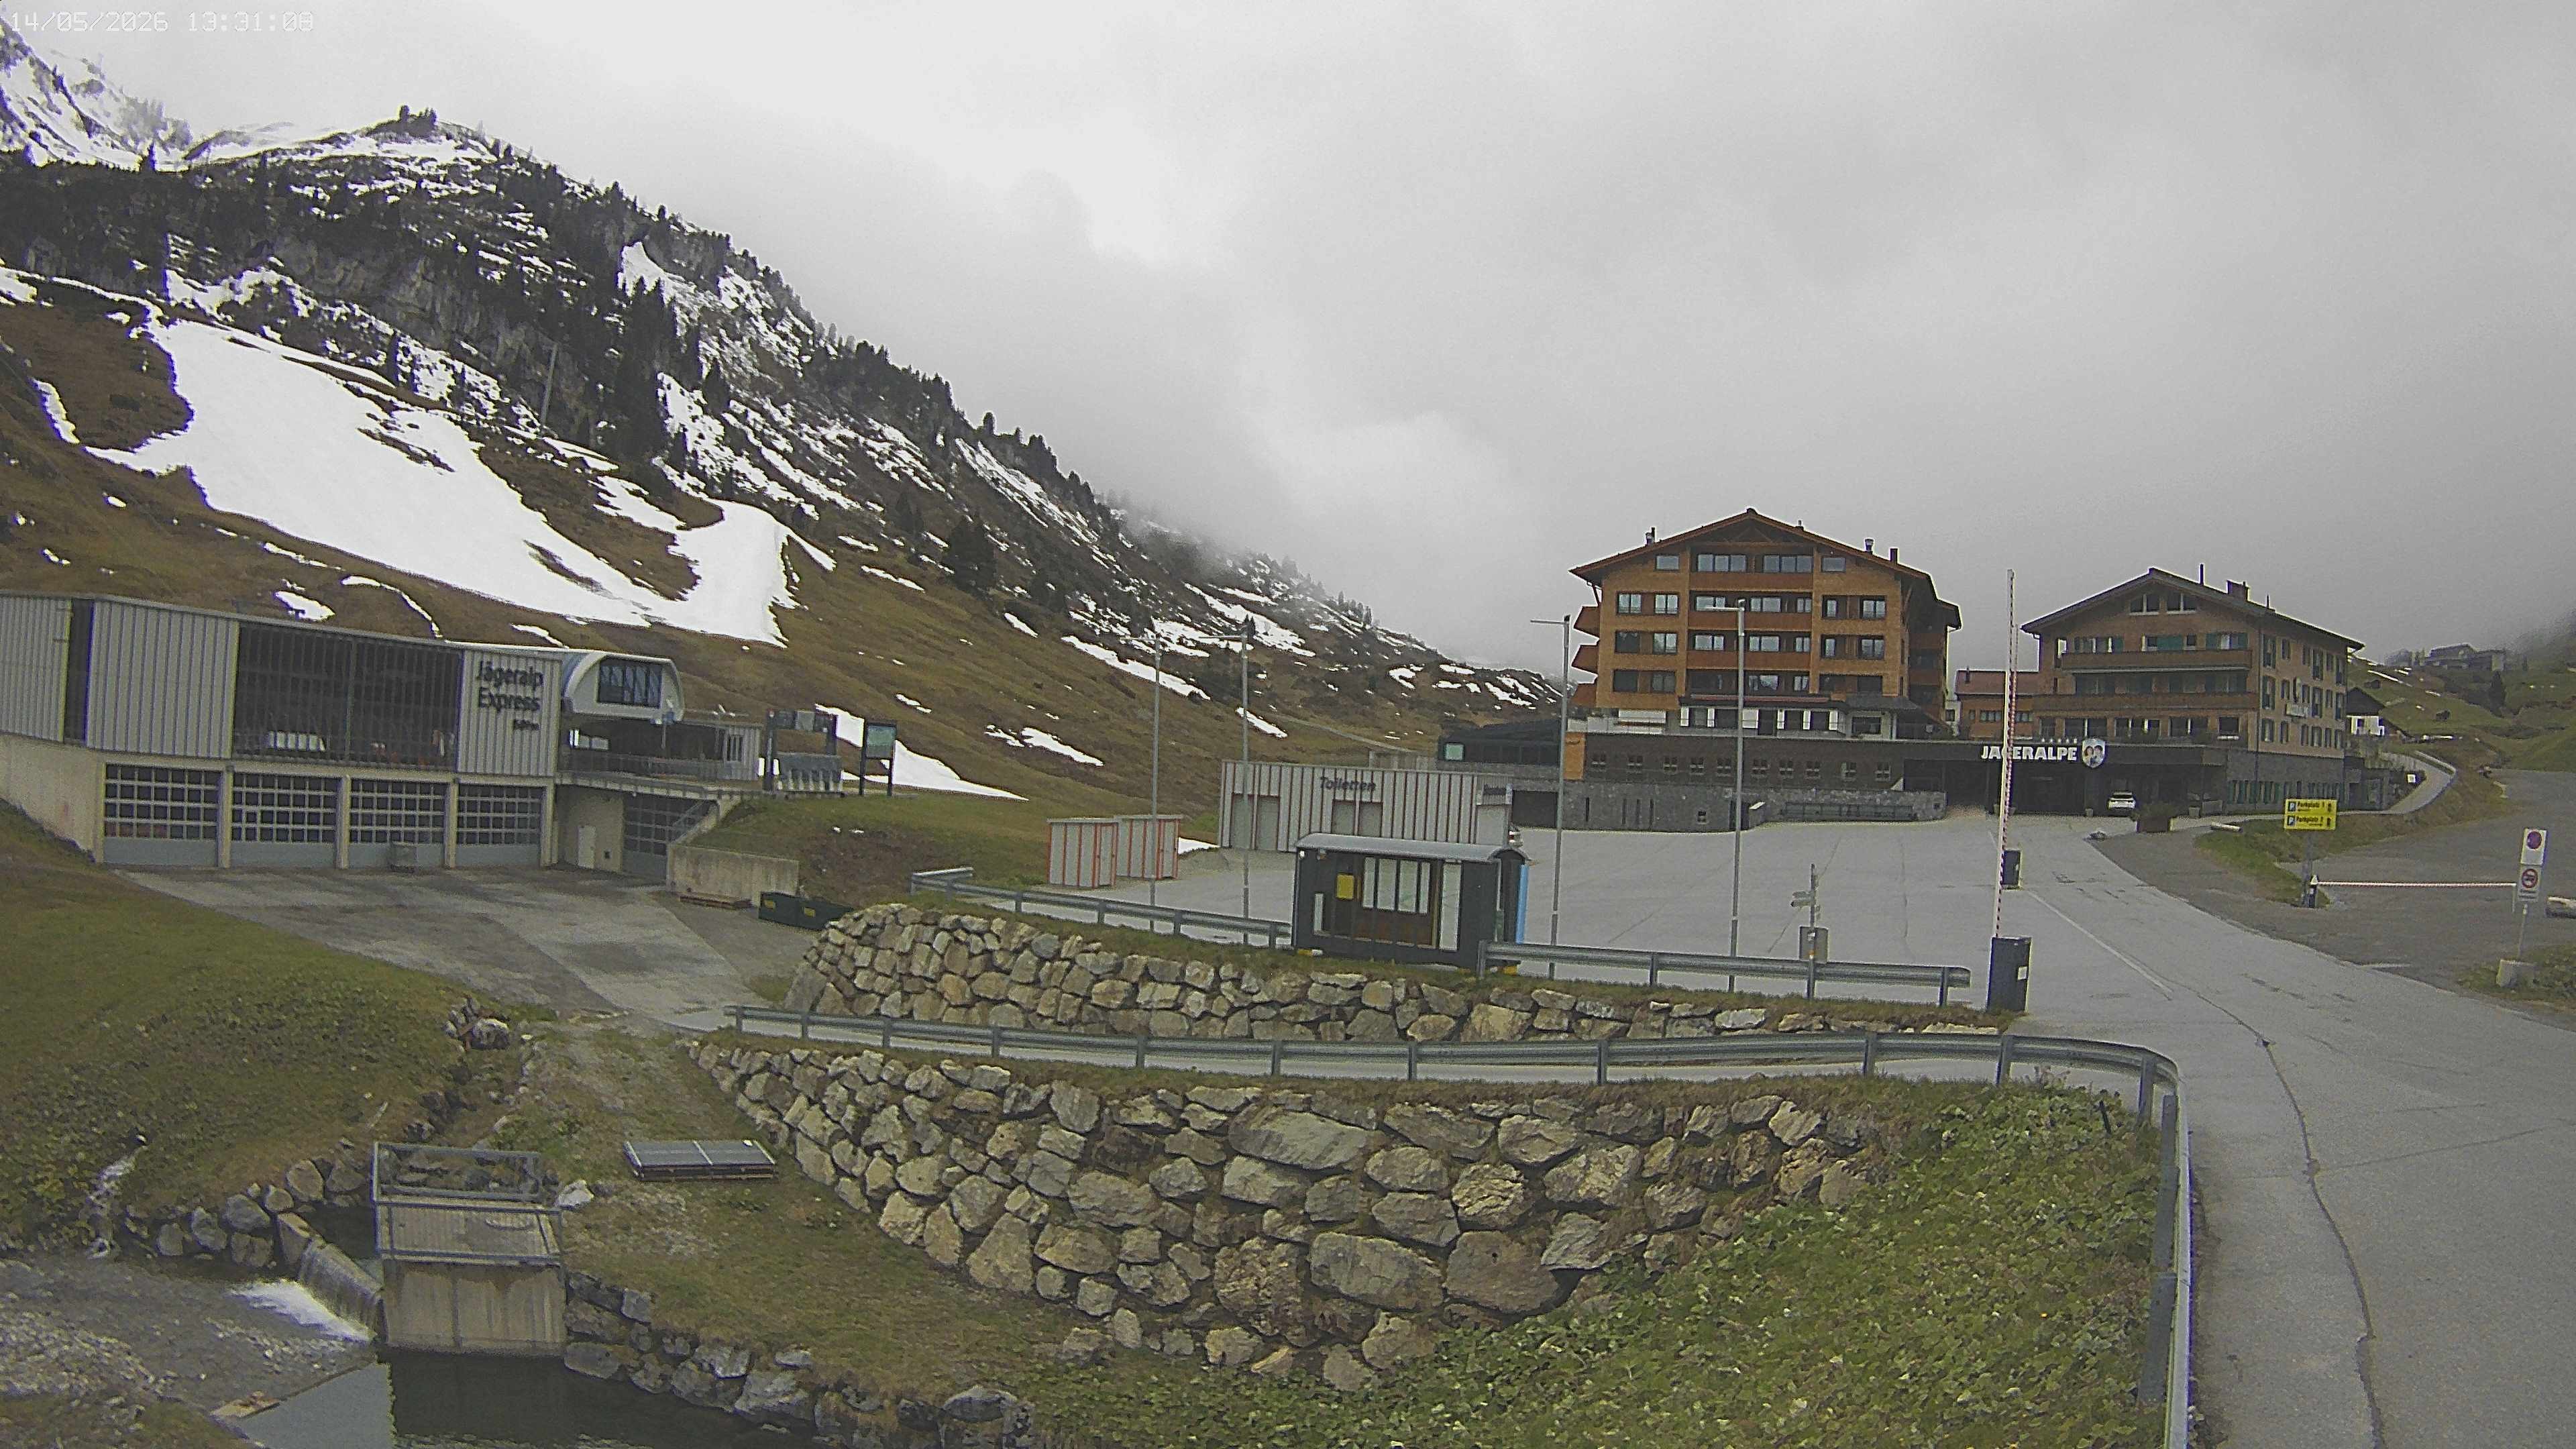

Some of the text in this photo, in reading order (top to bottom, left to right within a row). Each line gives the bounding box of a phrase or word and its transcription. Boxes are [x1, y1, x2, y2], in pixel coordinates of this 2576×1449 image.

[476, 660, 543, 690] Jägeralp
[478, 686, 541, 712] Express
[1981, 745, 2078, 761] JAERALPE
[1320, 776, 1377, 791] Toiletten
